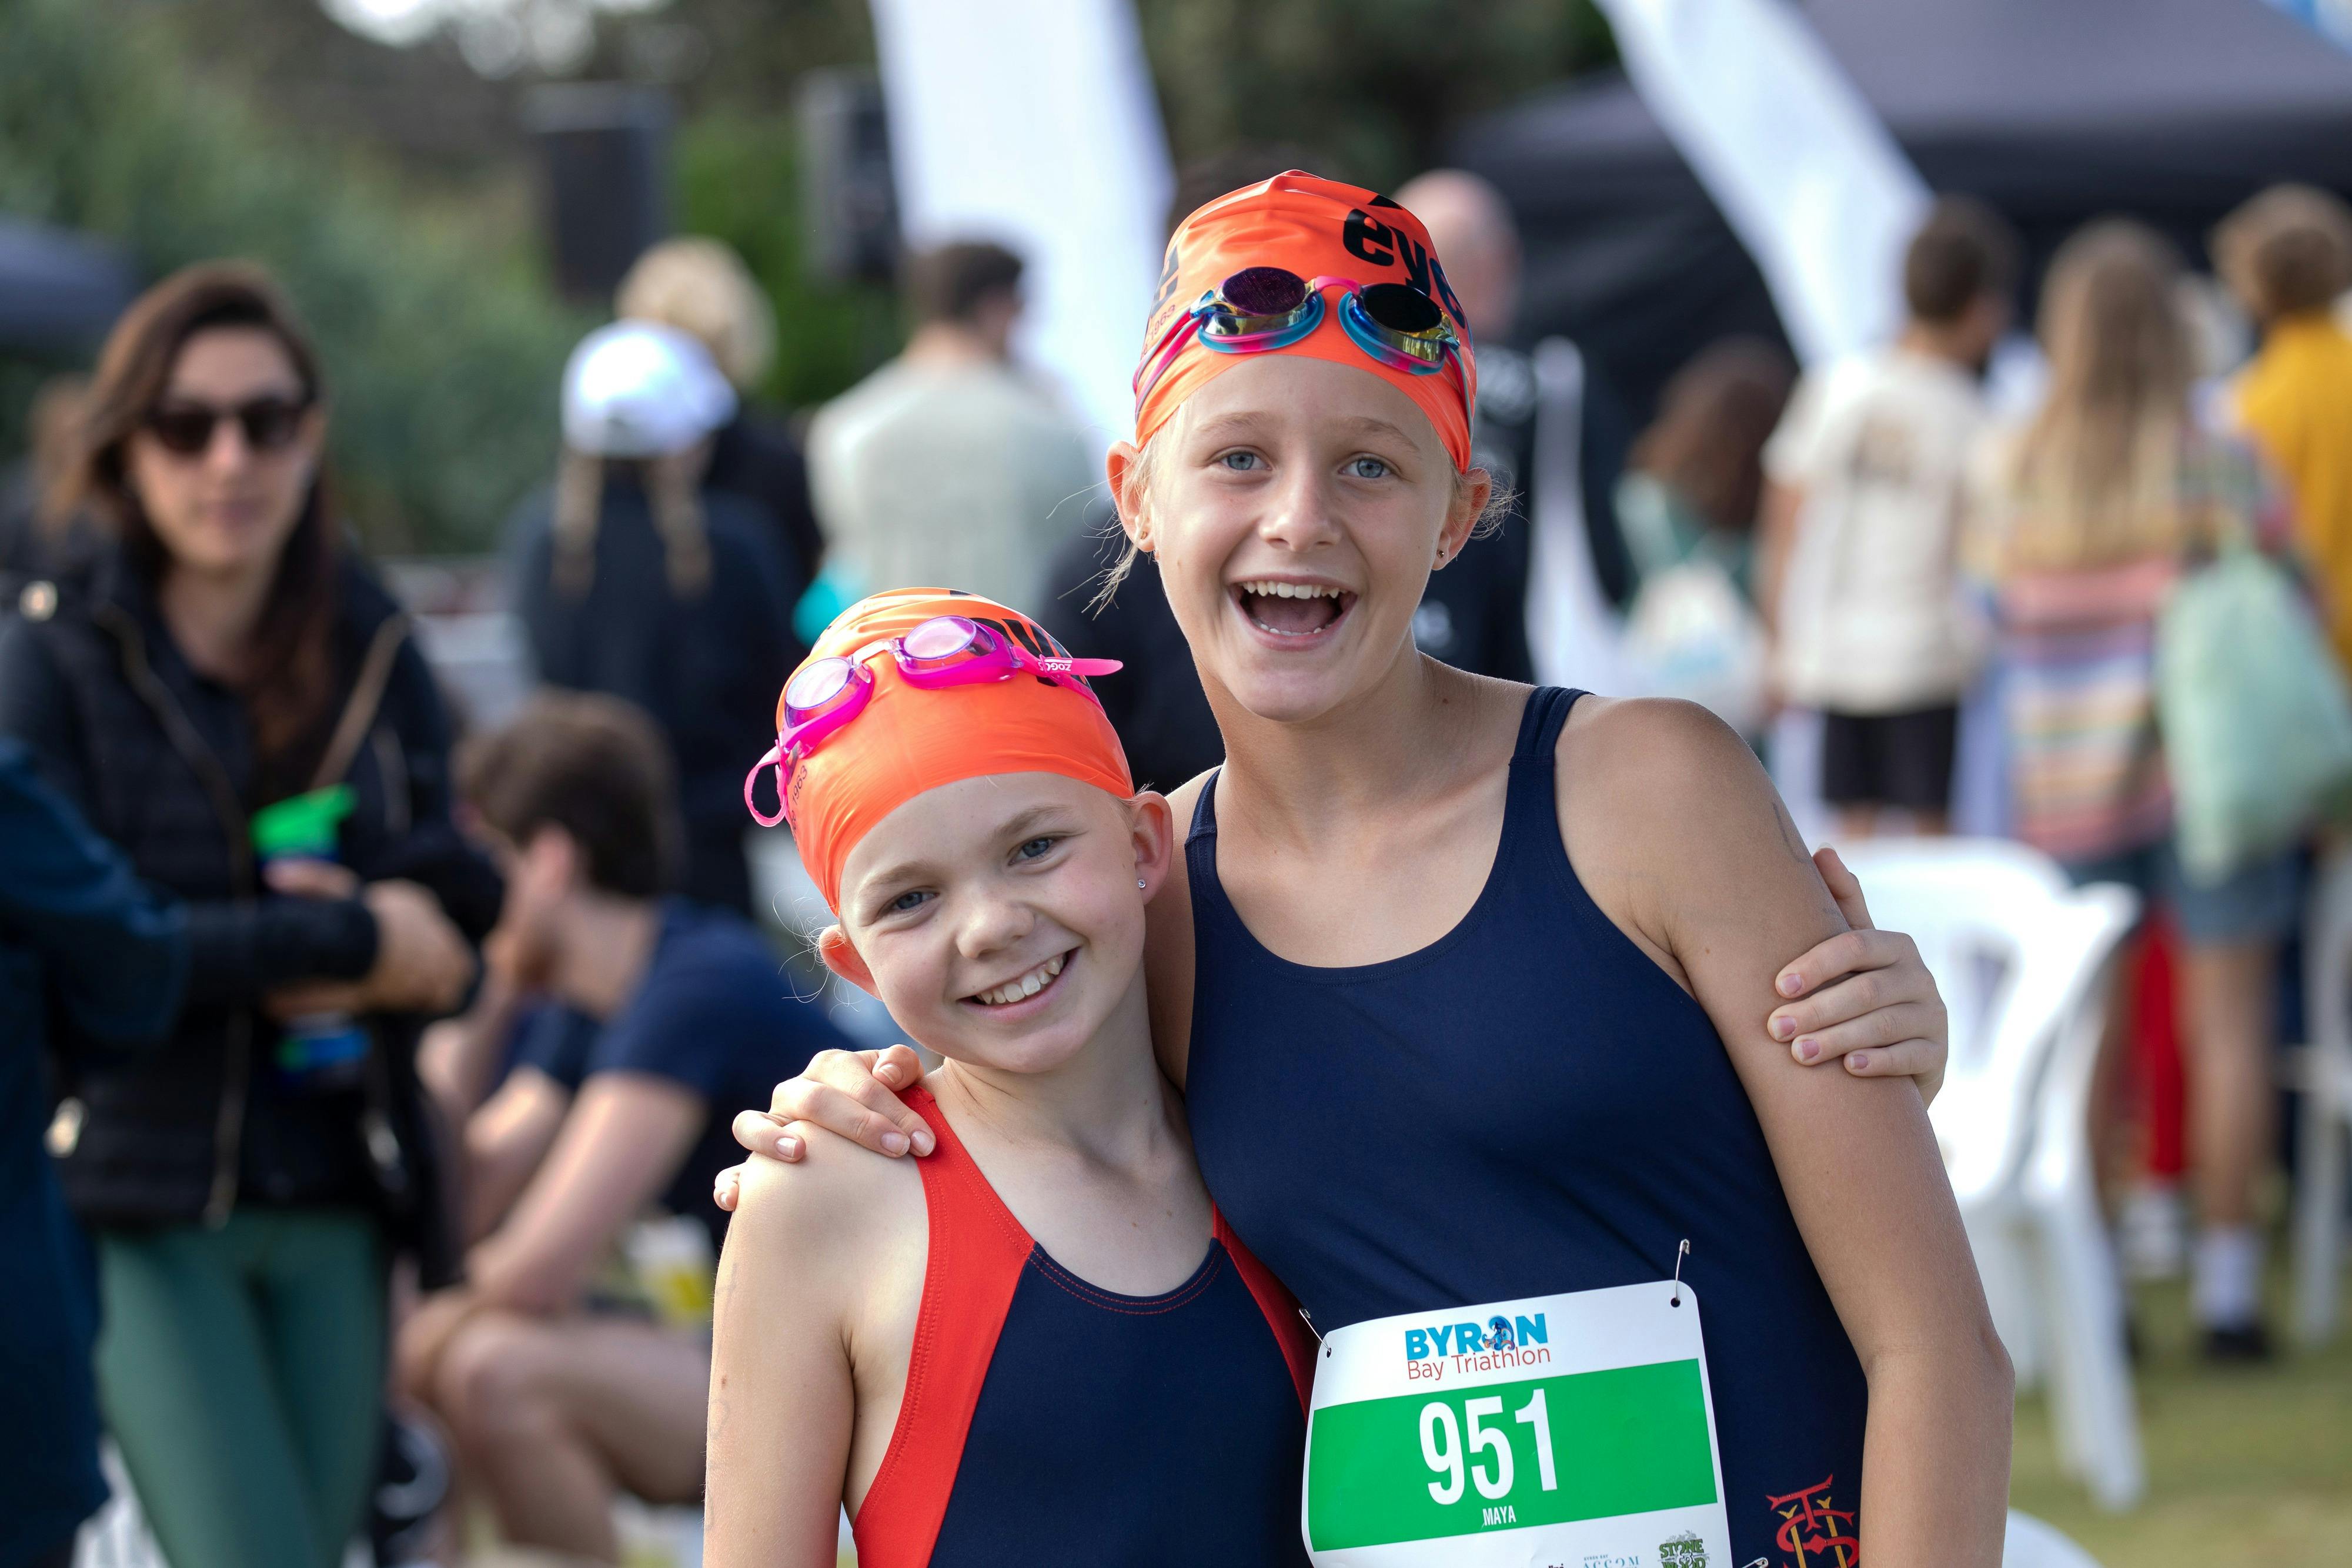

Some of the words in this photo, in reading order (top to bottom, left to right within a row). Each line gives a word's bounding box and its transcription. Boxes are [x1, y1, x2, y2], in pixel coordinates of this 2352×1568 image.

[792, 765, 808, 805] 1963
[1405, 1313, 1548, 1361] BYRON
[1408, 1360, 1444, 1381] Bay
[1451, 1346, 1551, 1374] Triathlon
[1419, 1388, 1558, 1505] 951
[1482, 1505, 1516, 1526] MAYA
[1659, 1538, 1705, 1558] STONE
